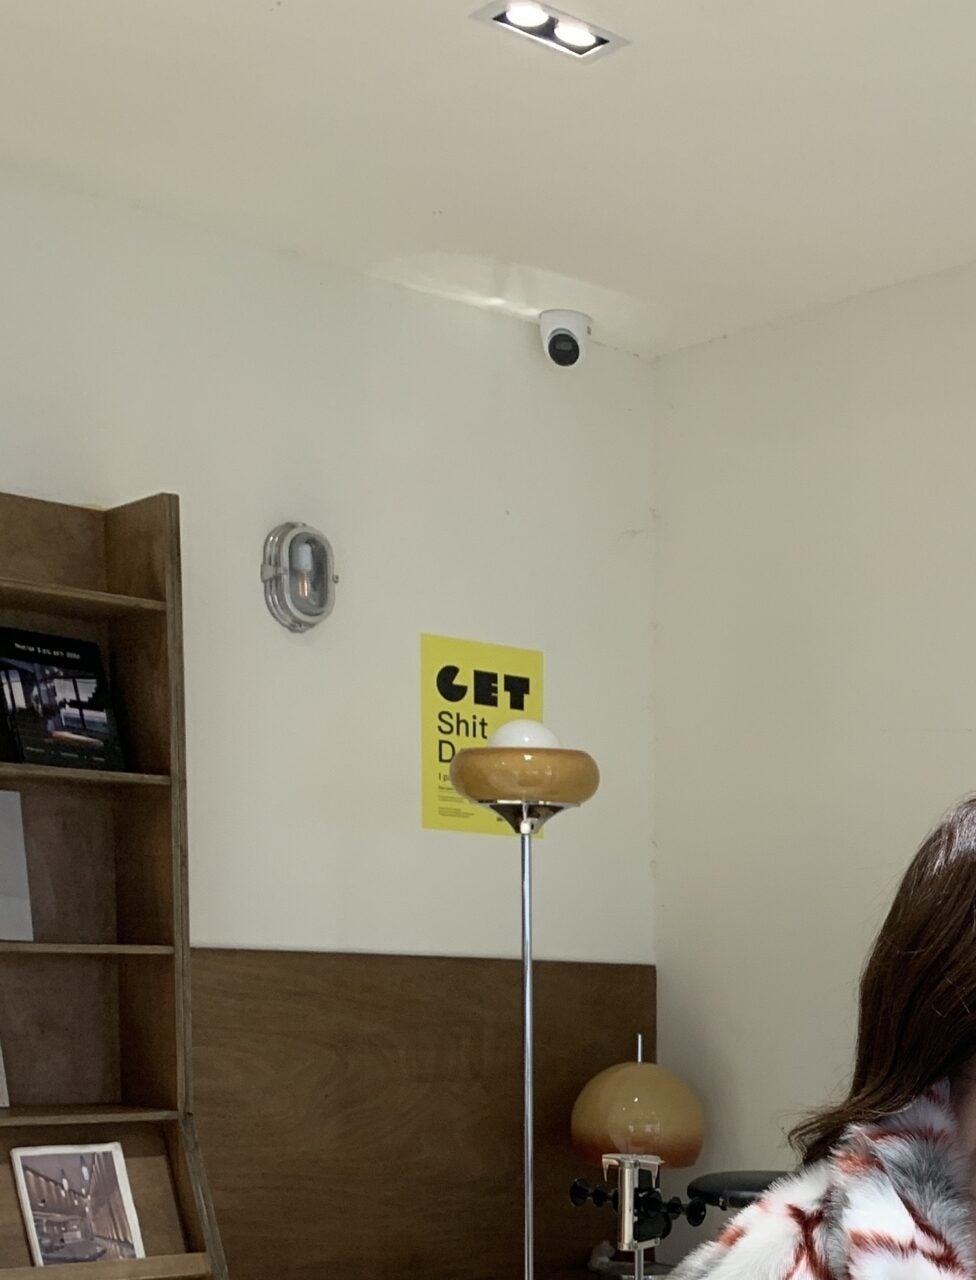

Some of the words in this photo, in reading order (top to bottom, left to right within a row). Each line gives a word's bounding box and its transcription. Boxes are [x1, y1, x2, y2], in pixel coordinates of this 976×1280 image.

[436, 664, 530, 711] GET
[437, 710, 488, 740] Shit
[438, 740, 460, 763] D
